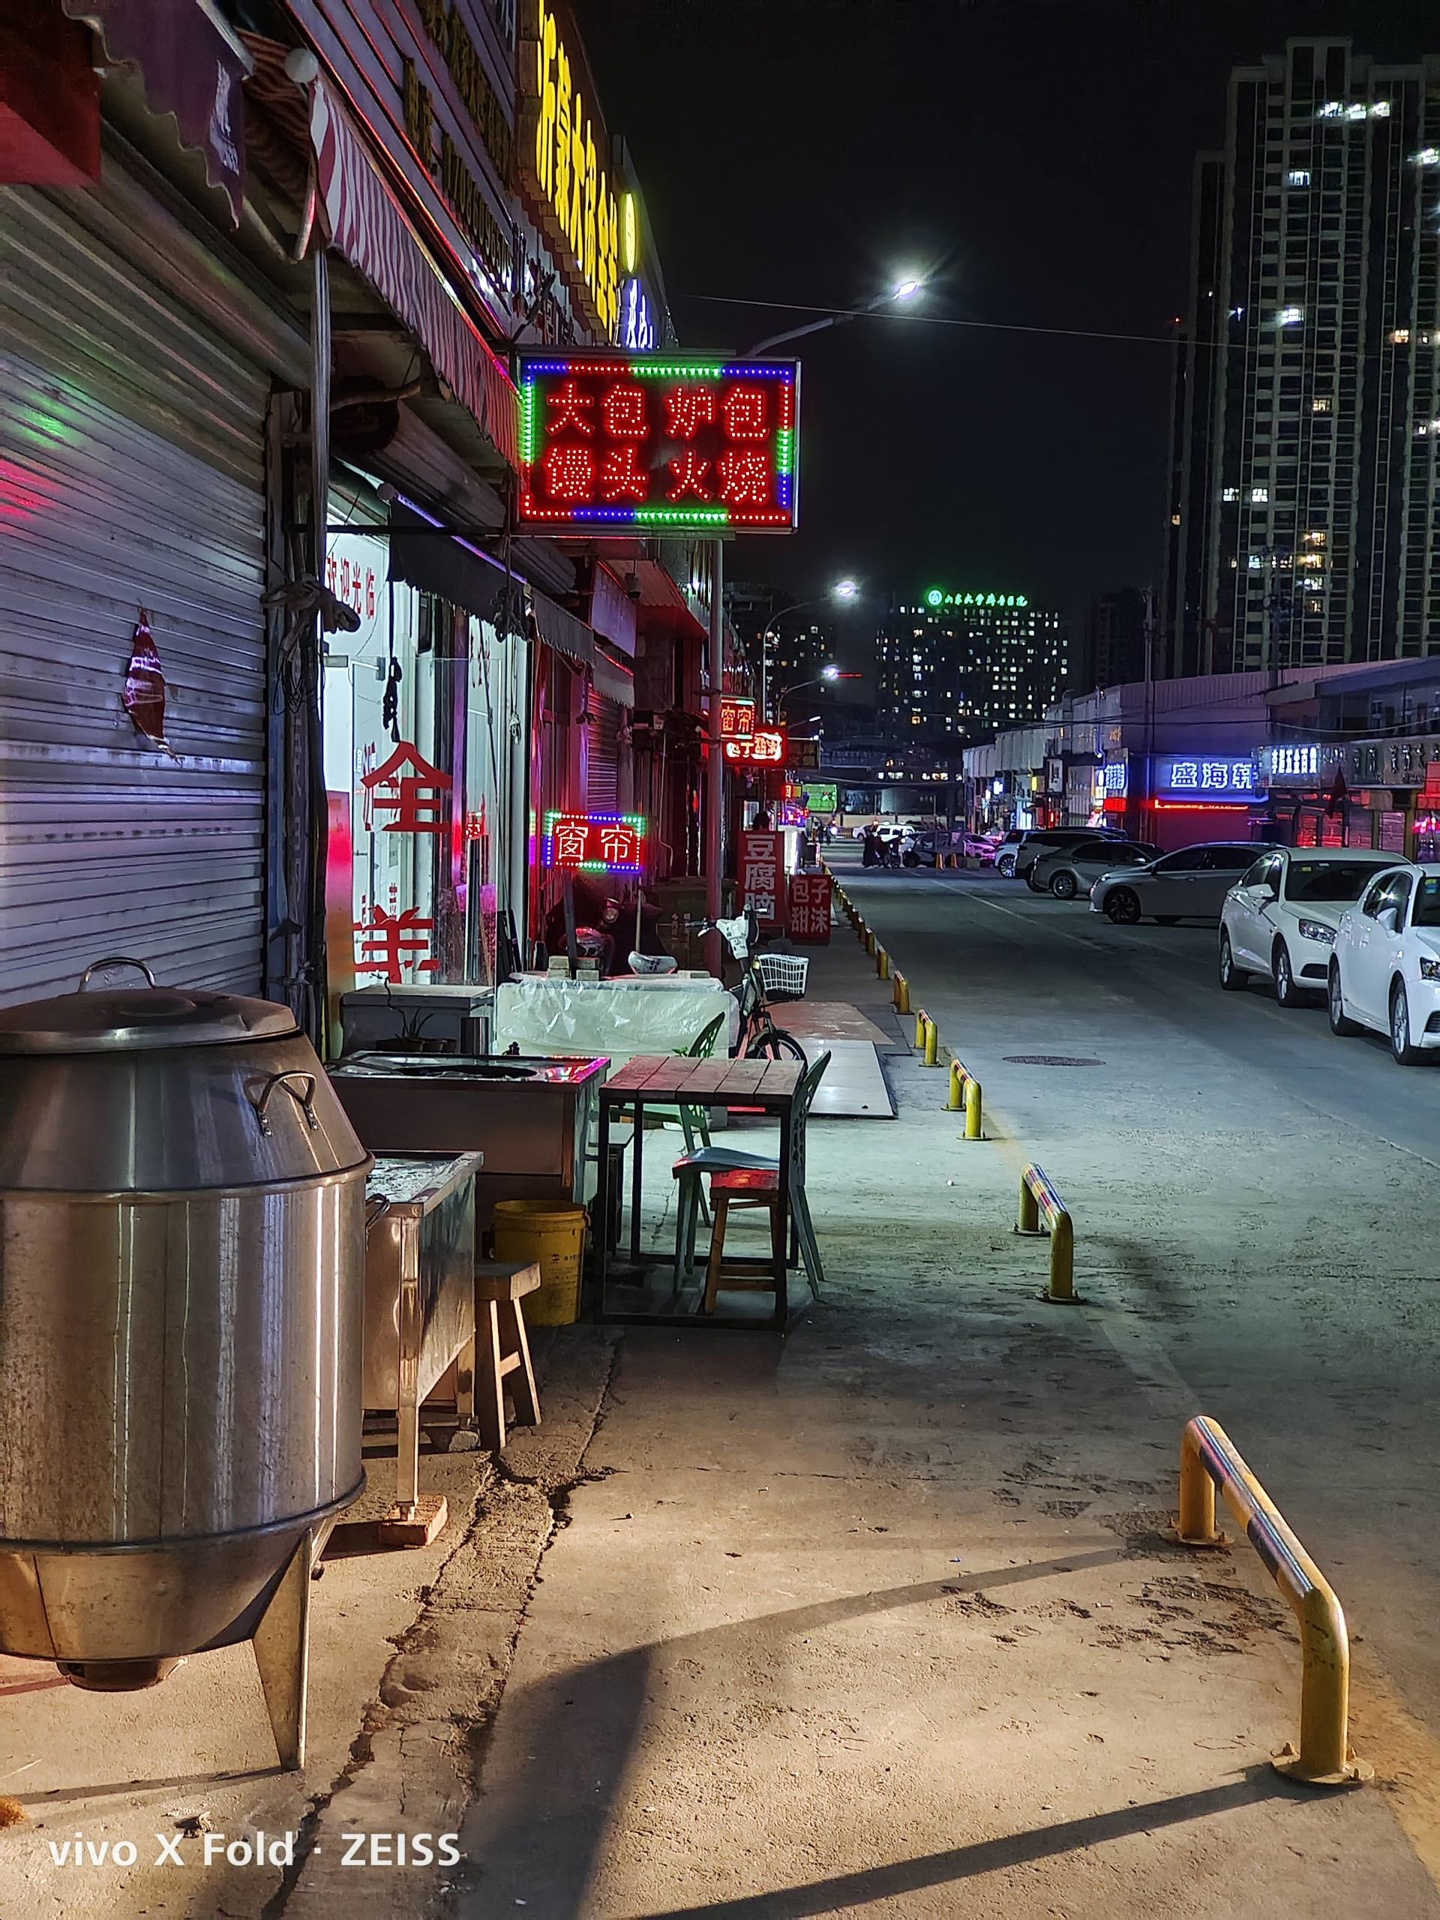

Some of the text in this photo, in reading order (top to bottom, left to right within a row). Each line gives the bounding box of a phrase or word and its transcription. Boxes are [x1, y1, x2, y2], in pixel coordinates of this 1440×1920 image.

[545, 380, 770, 440] 大包炉包
[720, 706, 752, 733] 窗帘
[555, 821, 634, 863] 窗帘
[743, 834, 776, 920] 豆腐脑
[792, 878, 829, 903] 包子
[791, 905, 829, 933] 甜沫
